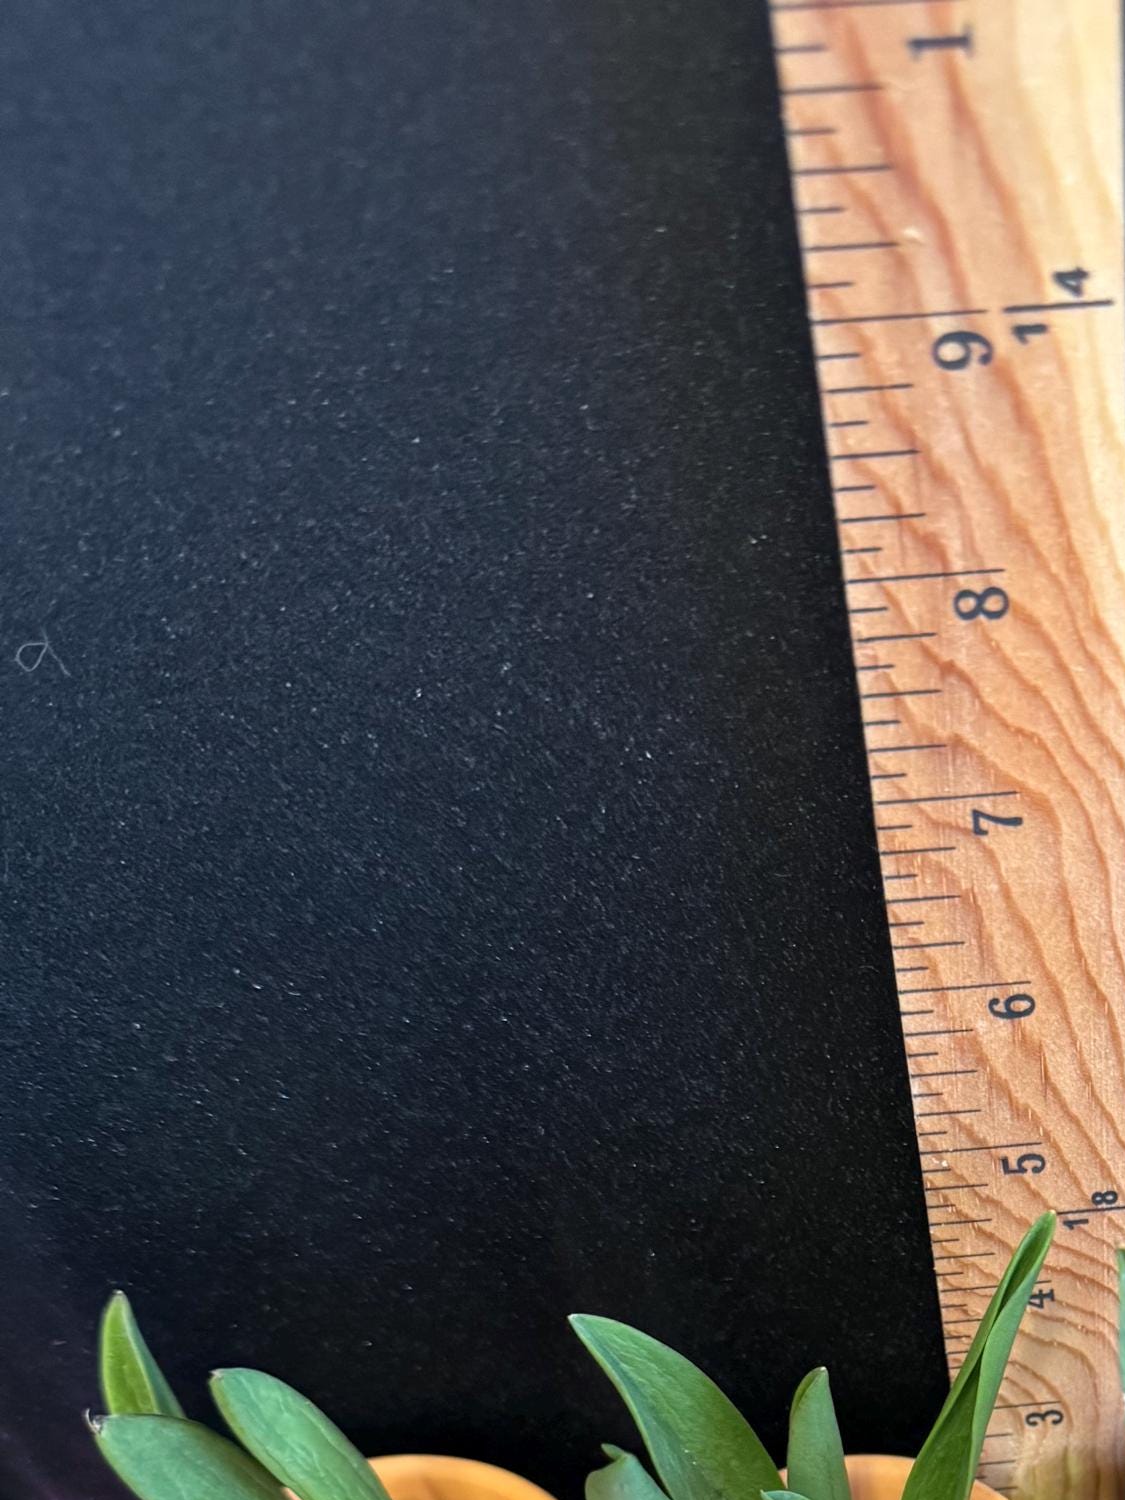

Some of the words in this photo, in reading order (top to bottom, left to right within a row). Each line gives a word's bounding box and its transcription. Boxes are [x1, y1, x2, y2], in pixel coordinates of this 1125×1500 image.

[1051, 266, 1090, 296] 4
[1011, 322, 1048, 345] 1
[931, 330, 994, 371] 9
[953, 587, 1009, 621] 8
[971, 808, 1023, 836] 7
[988, 994, 1036, 1020] 6
[1001, 1153, 1046, 1175] 5
[1091, 1189, 1119, 1206] 8
[1063, 1218, 1089, 1231] 1
[1028, 1288, 1055, 1309] 4
[1025, 1408, 1064, 1427] 3
